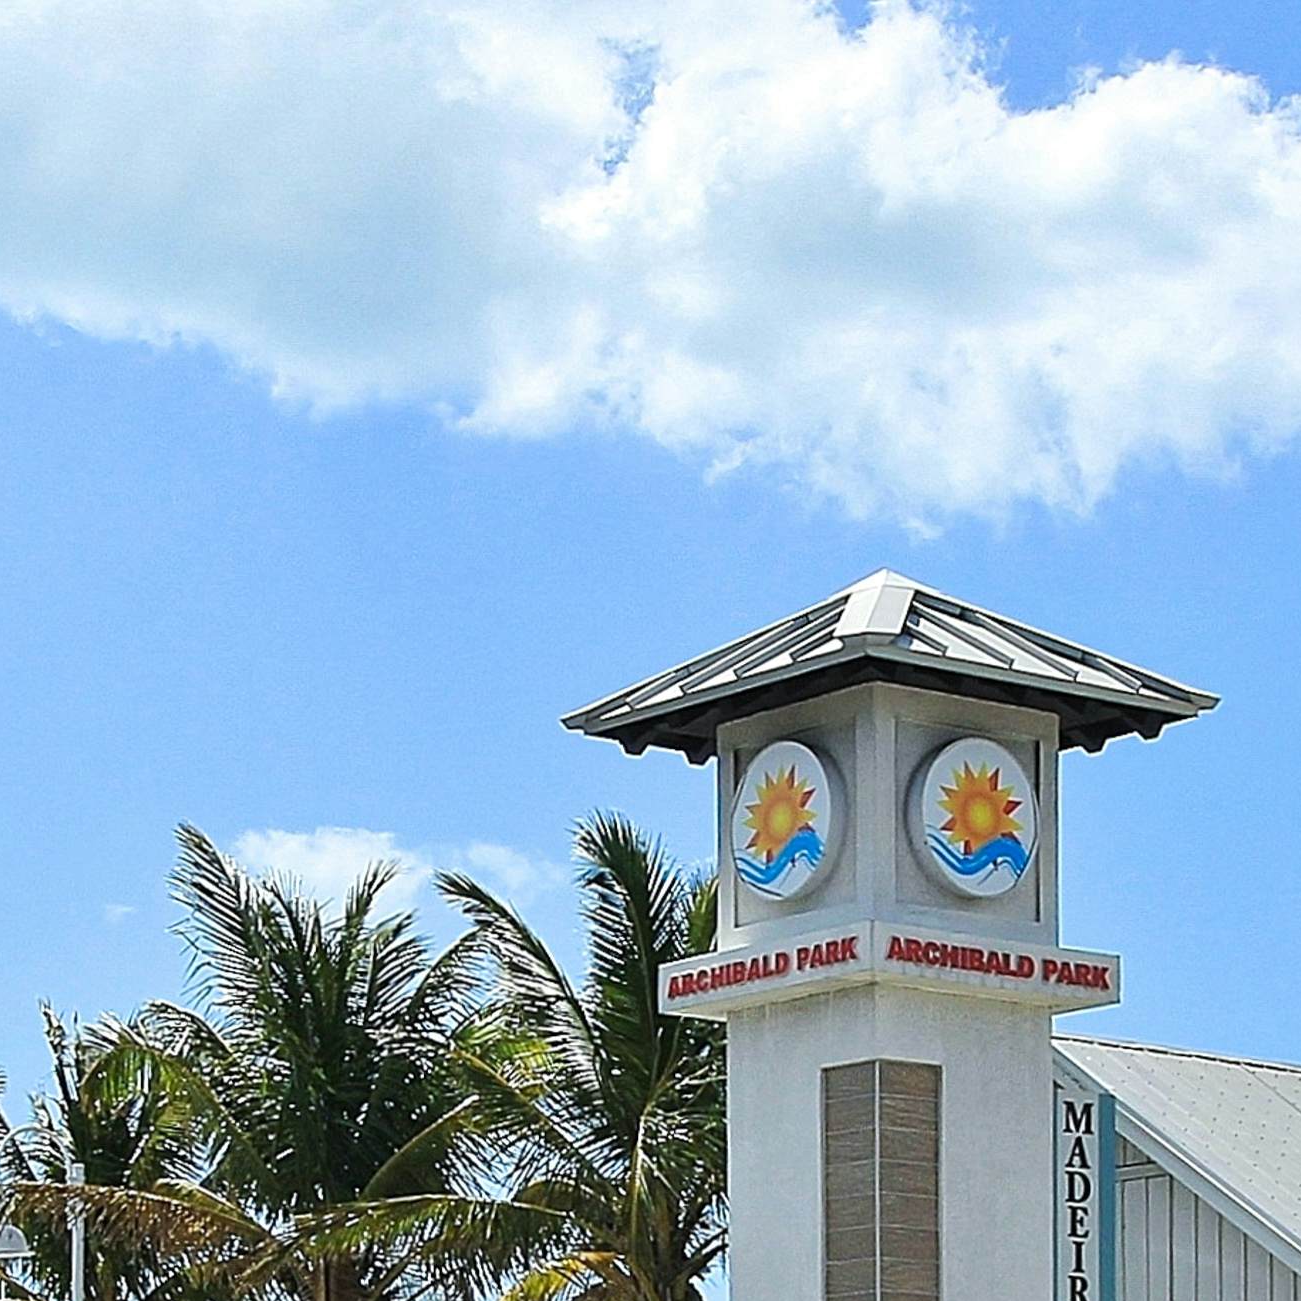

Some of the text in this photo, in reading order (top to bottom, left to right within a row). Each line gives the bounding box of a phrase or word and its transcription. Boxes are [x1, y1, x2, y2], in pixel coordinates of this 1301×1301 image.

[667, 936, 859, 998] ARCHIBALD PARK
[887, 936, 1110, 990] ARCHIBALD PARK
